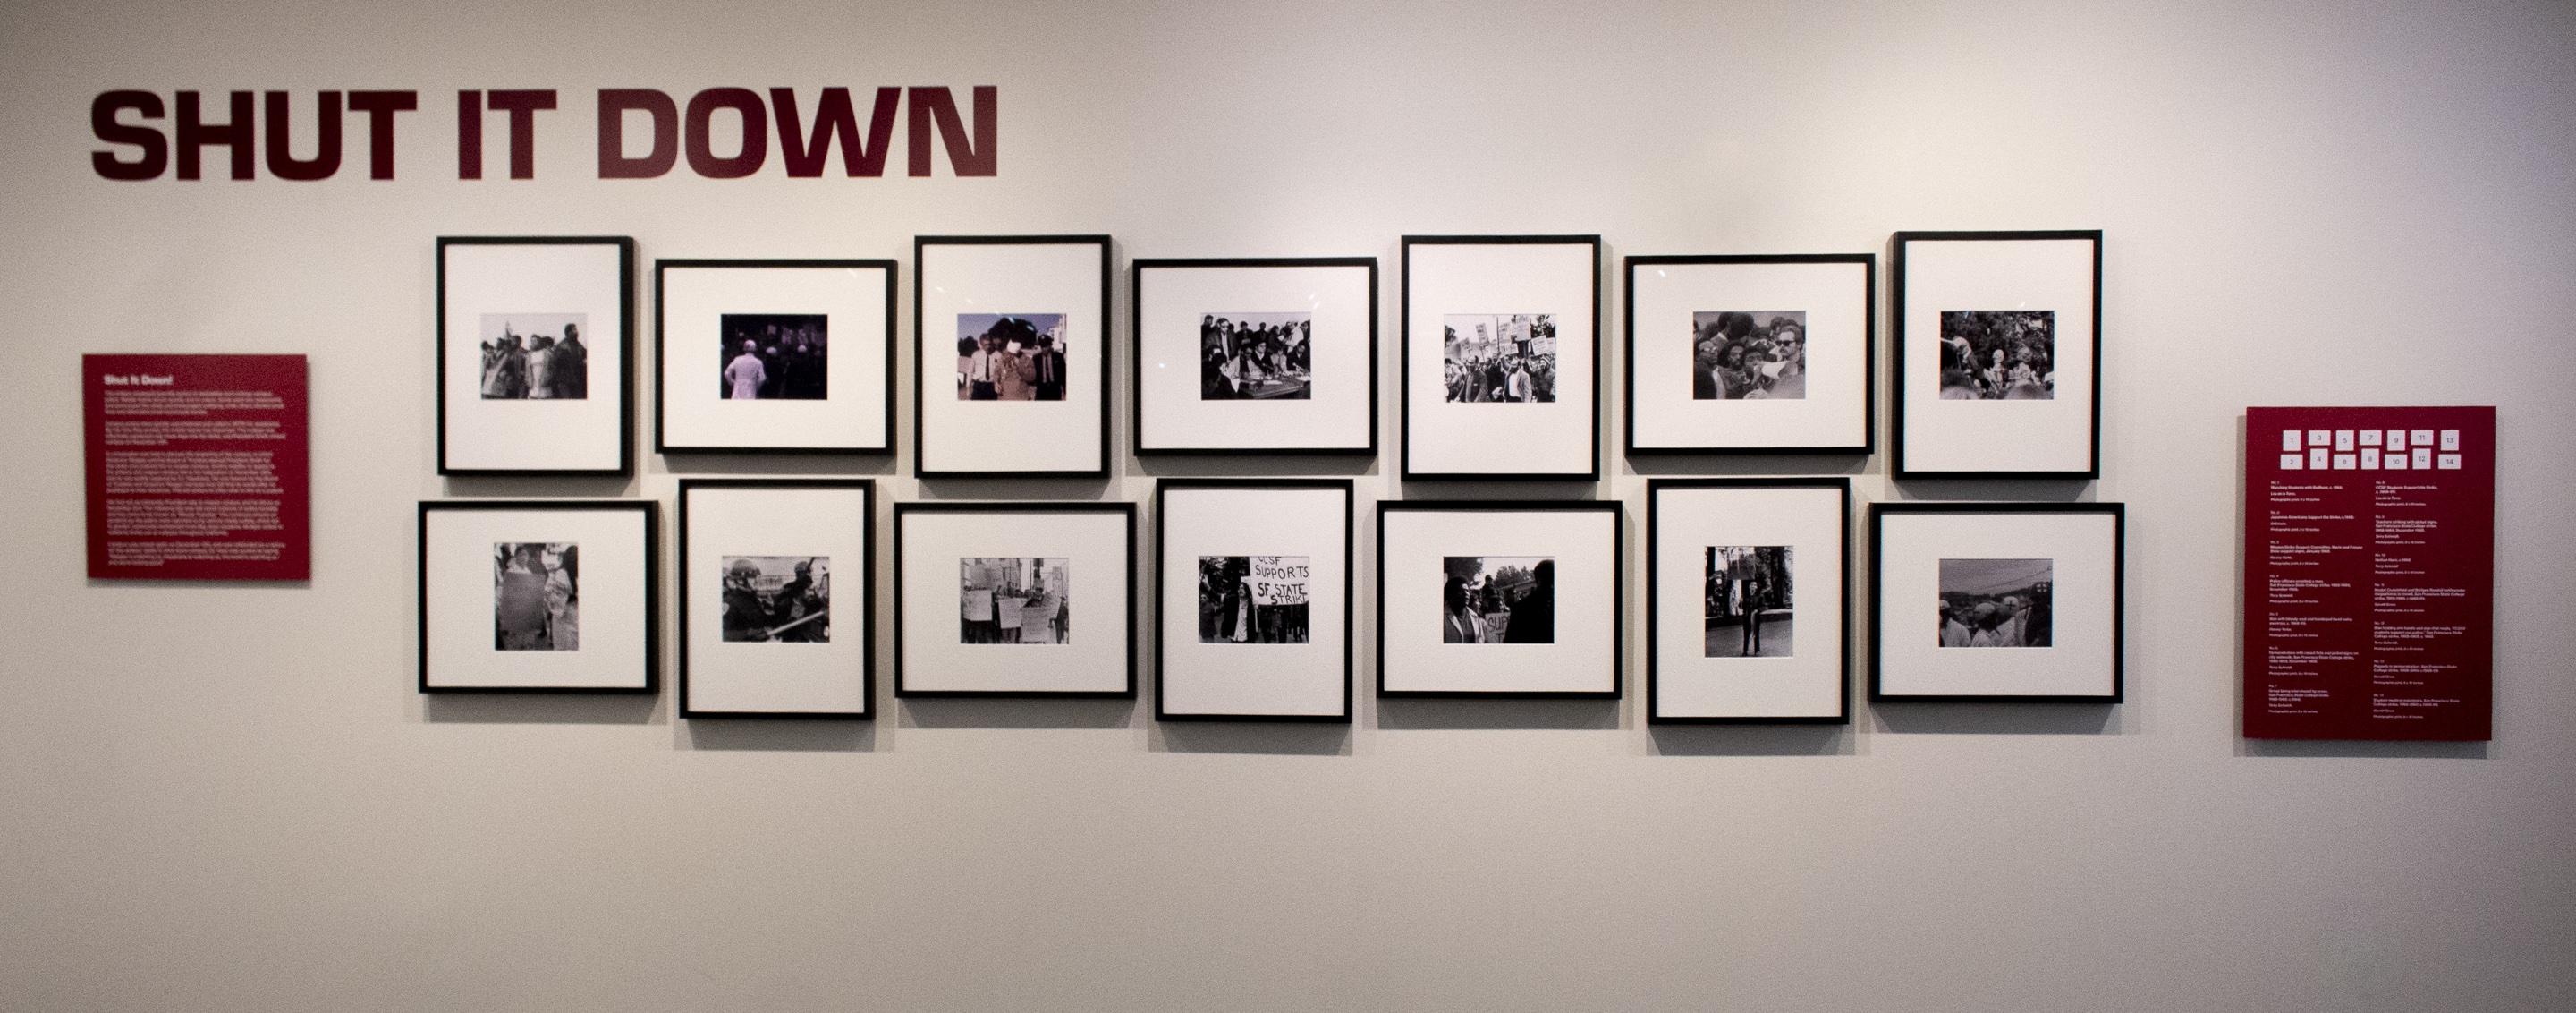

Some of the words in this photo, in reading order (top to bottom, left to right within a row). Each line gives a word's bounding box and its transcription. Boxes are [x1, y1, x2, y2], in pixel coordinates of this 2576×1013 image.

[90, 88, 419, 181] SHUT
[457, 89, 557, 180] IT
[597, 85, 997, 179] DOWN
[1256, 565, 1309, 579] SUPPORTS
[1258, 583, 1270, 597] SF
[1275, 583, 1307, 596] STATE
